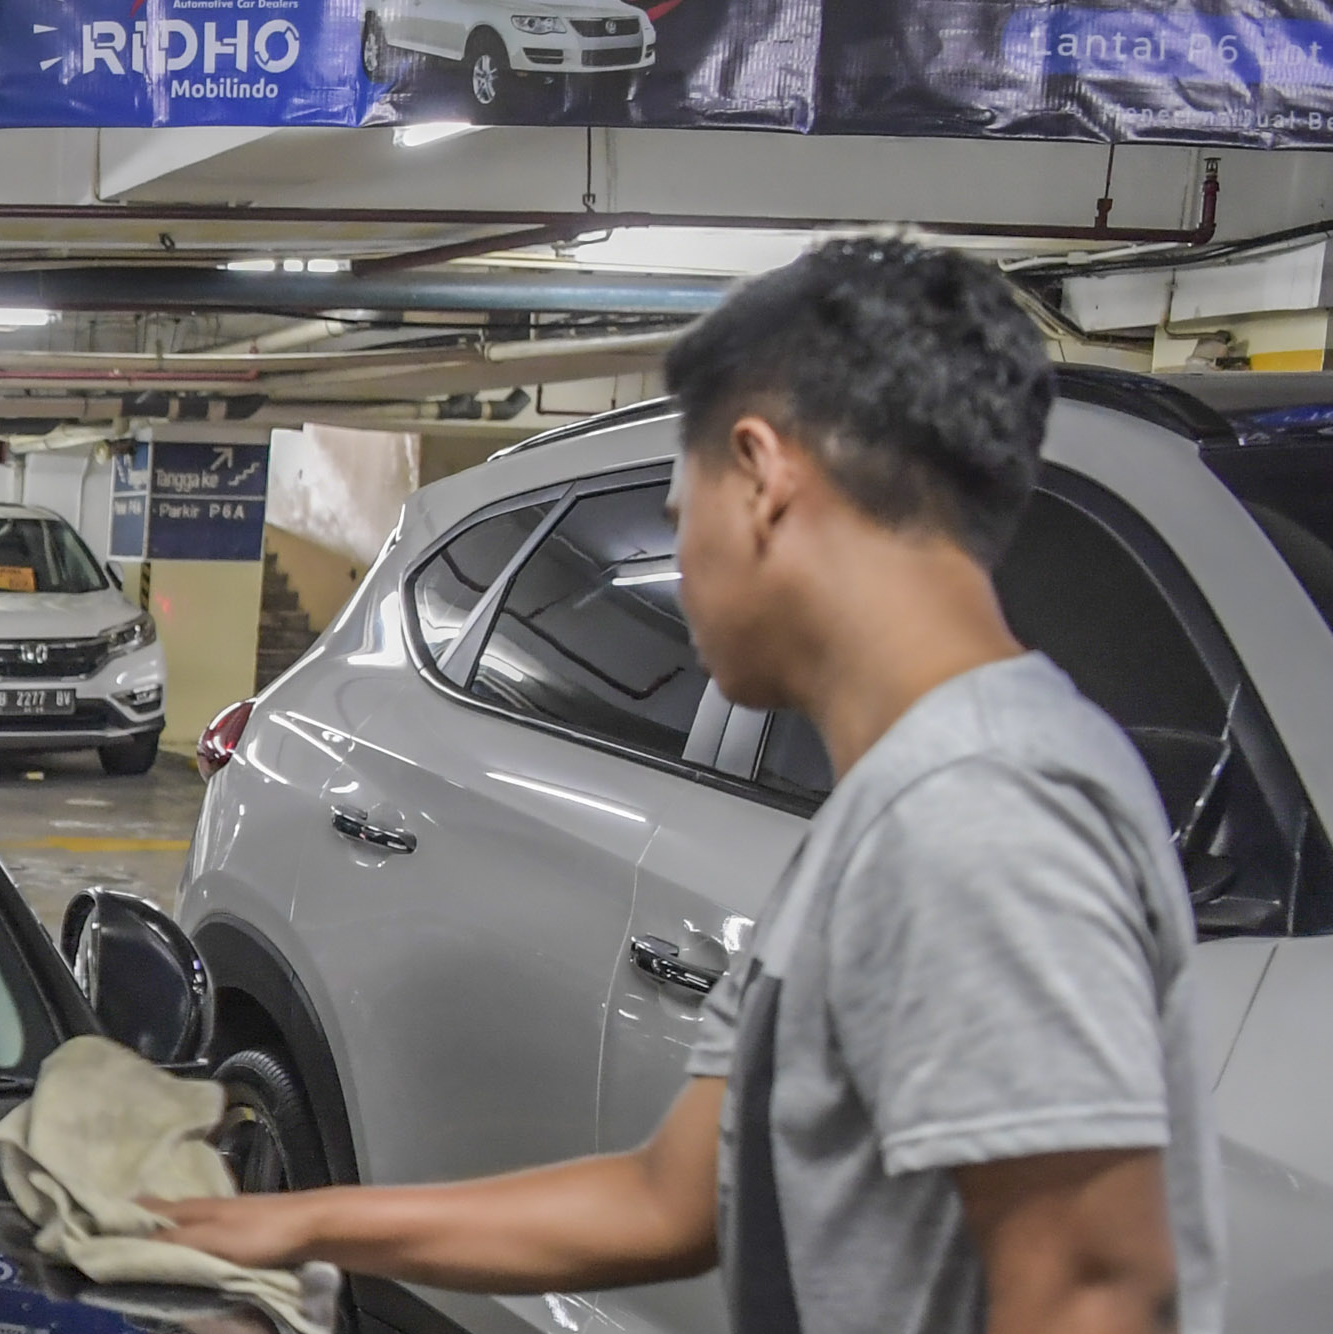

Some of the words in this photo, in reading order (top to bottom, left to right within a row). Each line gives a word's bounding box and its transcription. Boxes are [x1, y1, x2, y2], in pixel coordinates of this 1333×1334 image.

[237, 0, 255, 9] Car
[258, 0, 299, 9] Dealers
[82, 19, 300, 75] RIDHO
[1033, 29, 1167, 62] Lantai
[1188, 33, 1239, 65] P6
[170, 78, 279, 99] Mobilindo
[155, 469, 200, 492] Tangga
[201, 470, 219, 489] ke
[159, 503, 201, 519] Parkir
